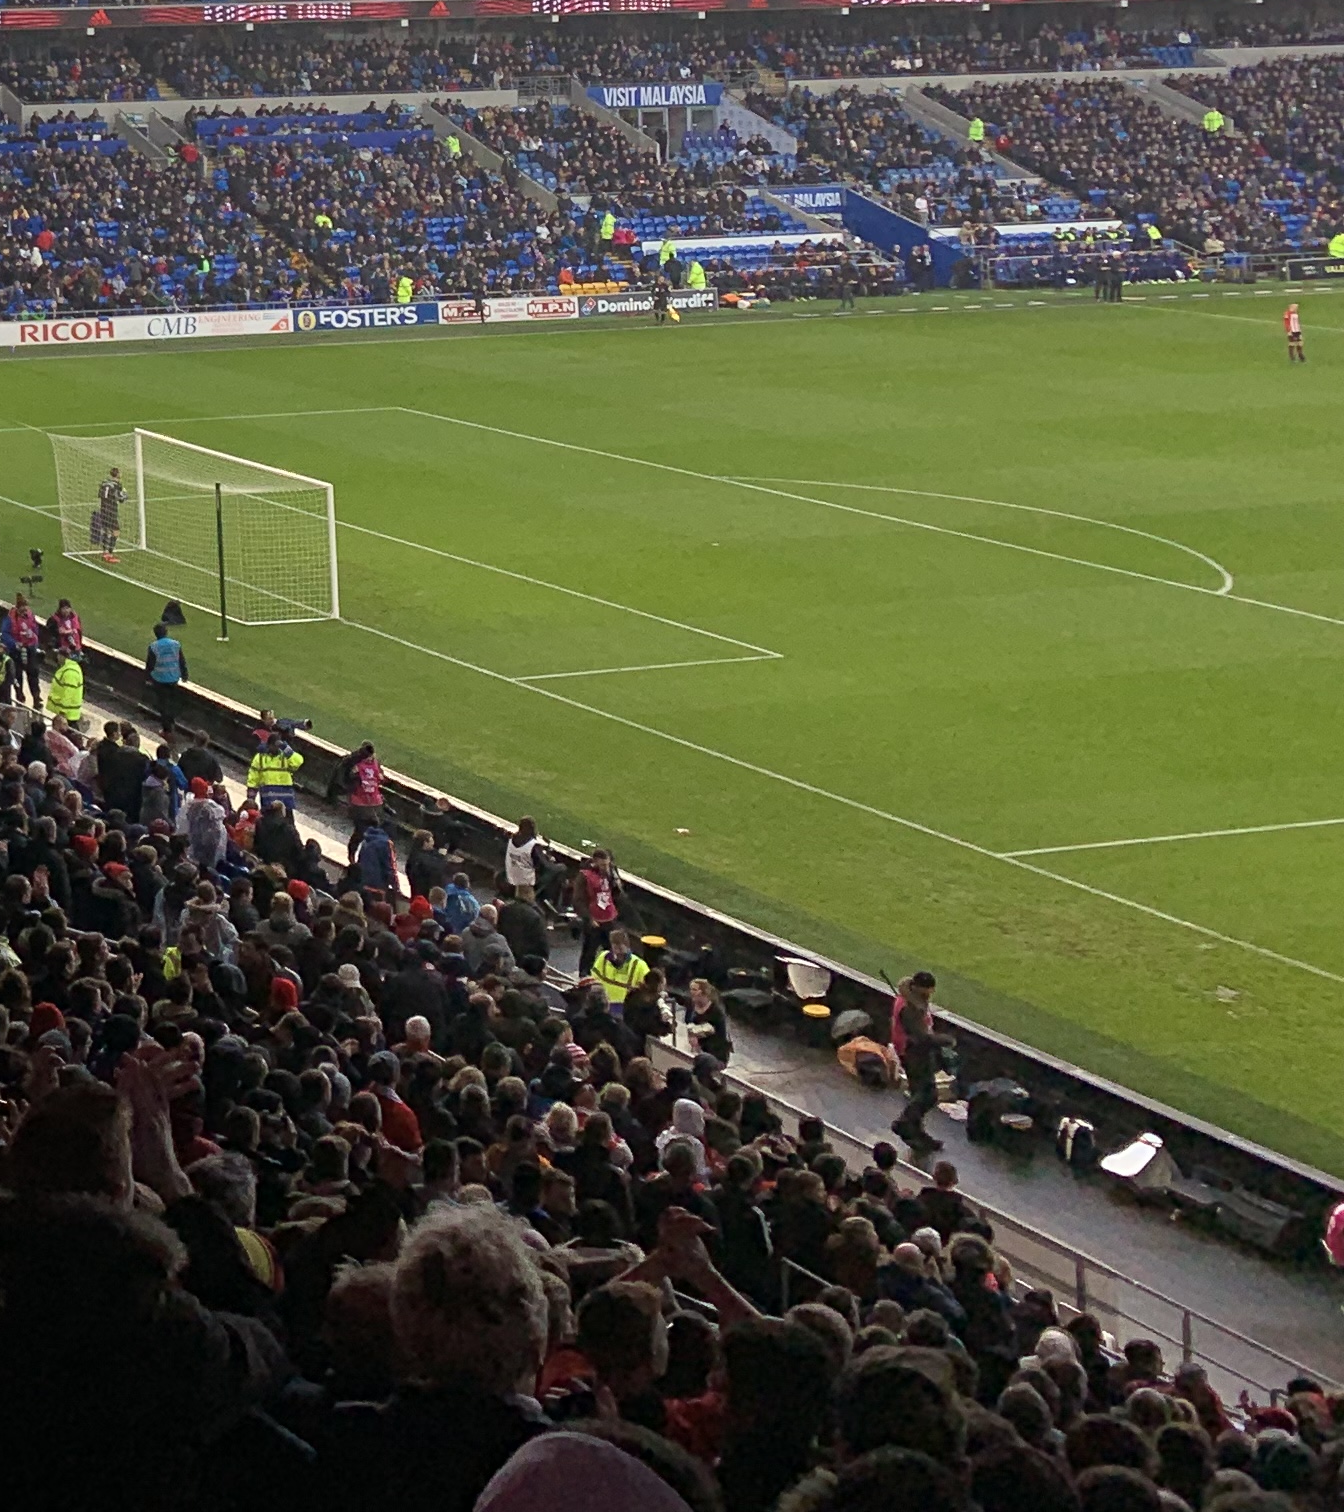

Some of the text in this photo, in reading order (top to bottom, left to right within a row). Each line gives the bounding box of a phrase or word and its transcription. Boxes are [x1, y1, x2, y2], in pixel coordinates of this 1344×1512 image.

[603, 85, 706, 106] VISIT MALAYSIA
[319, 305, 418, 328] FOSTER'S
[528, 301, 575, 314] M.P.N
[20, 320, 115, 343] RICOH
[147, 316, 197, 337] CMB
[199, 312, 261, 323] ENGINEERING
